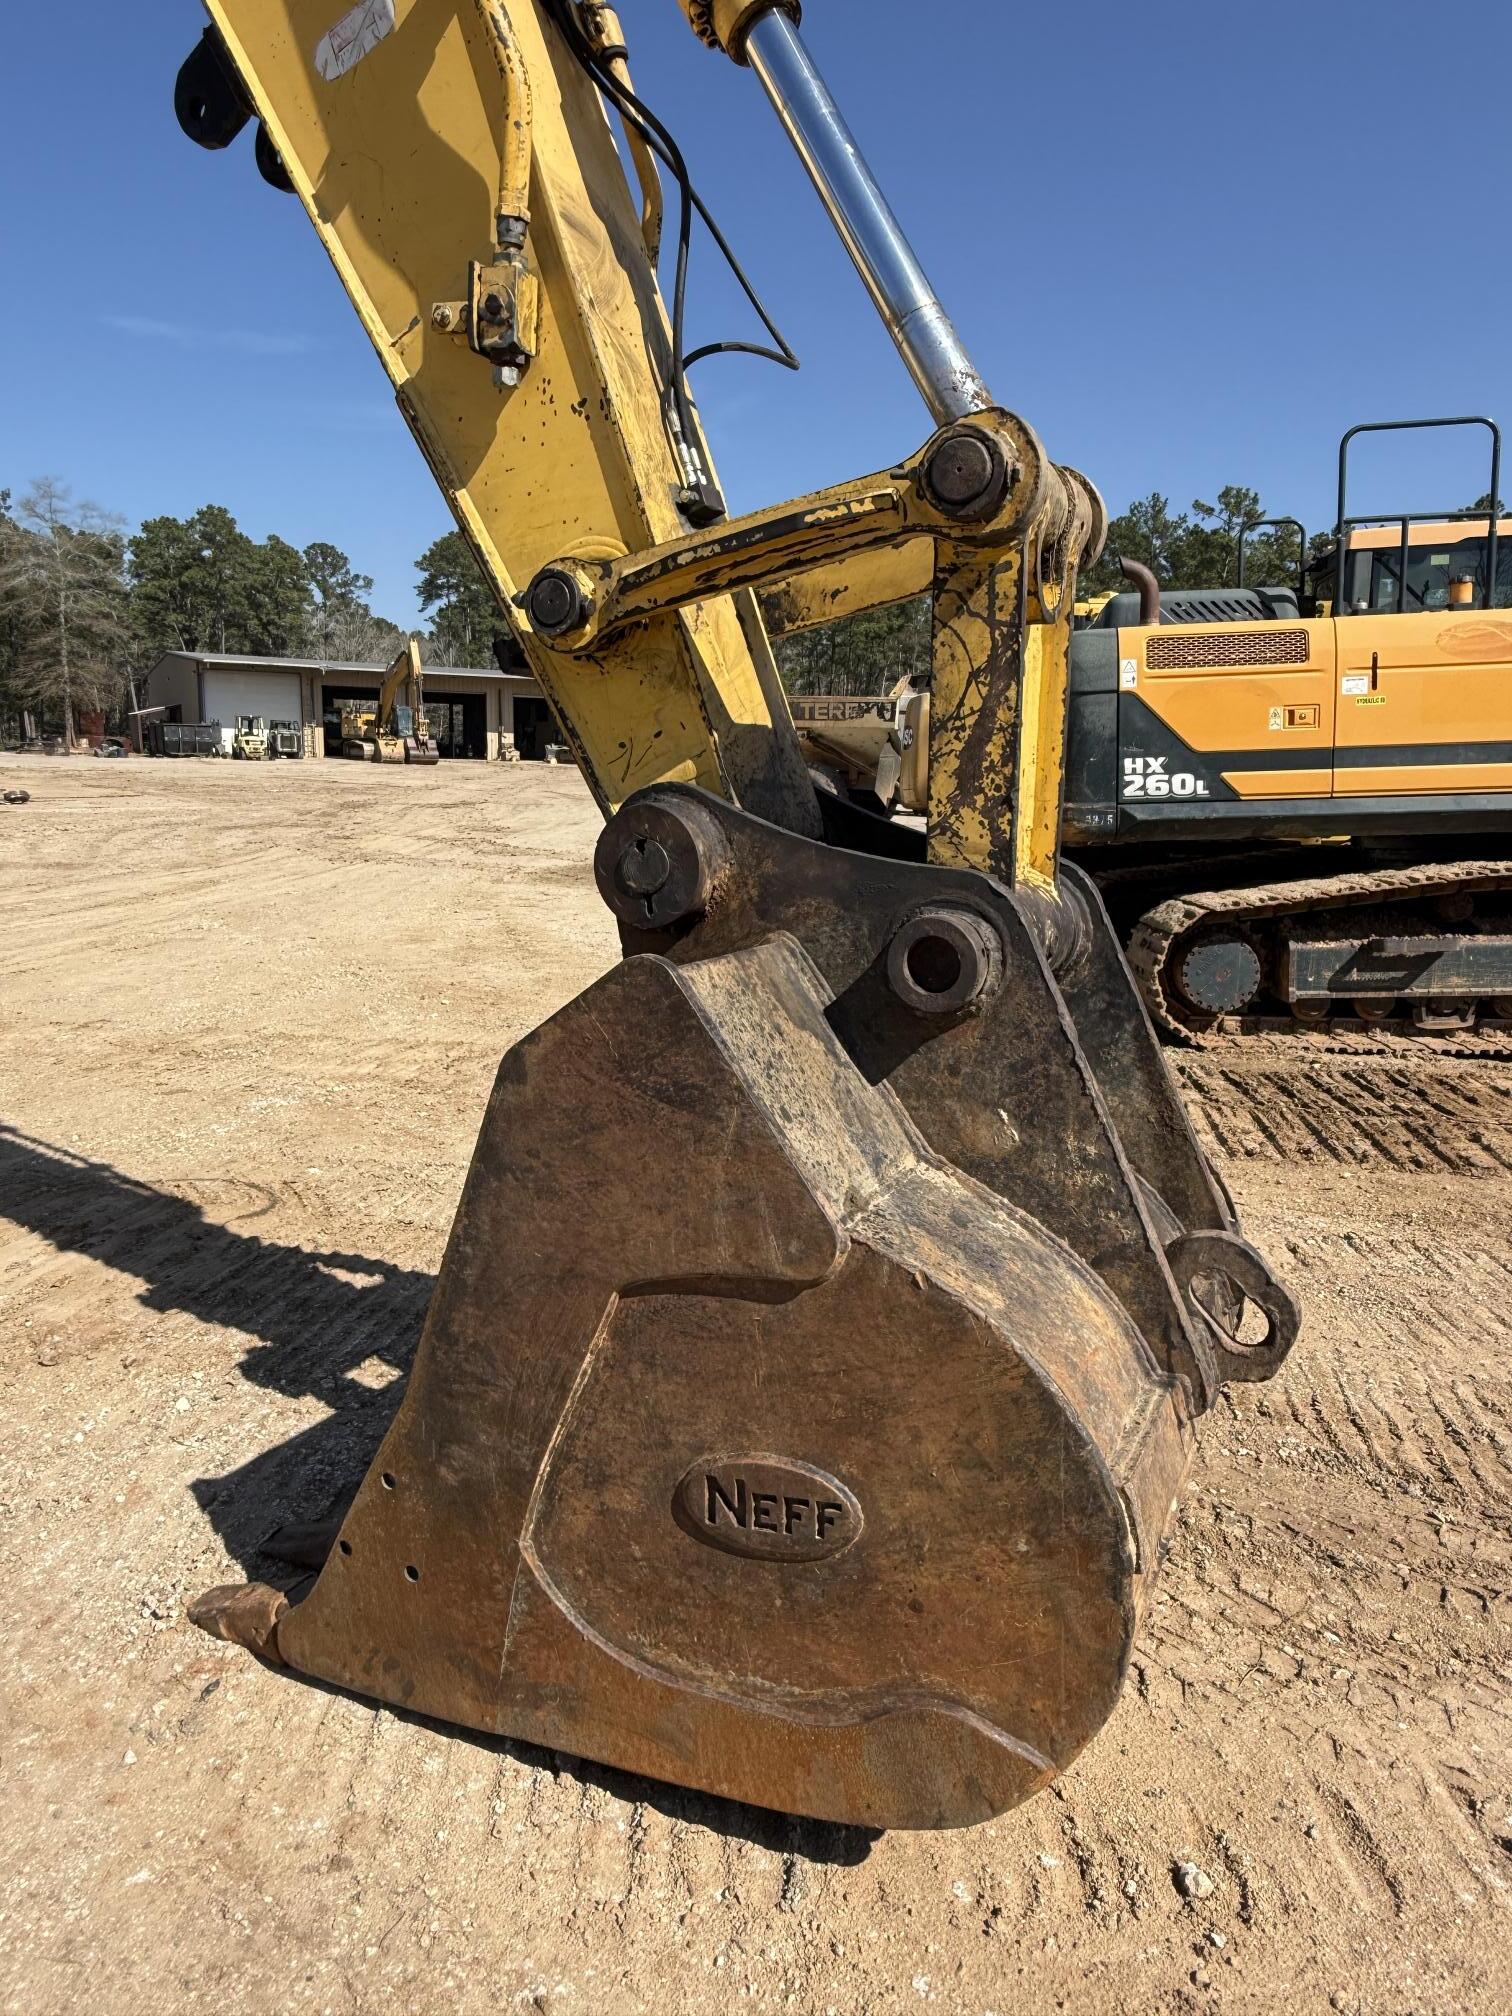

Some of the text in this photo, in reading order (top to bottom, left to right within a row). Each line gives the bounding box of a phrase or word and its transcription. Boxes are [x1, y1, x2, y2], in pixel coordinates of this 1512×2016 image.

[1124, 756, 1166, 774] HX
[1123, 773, 1210, 797] 260L
[705, 1474, 842, 1539] NEFF
